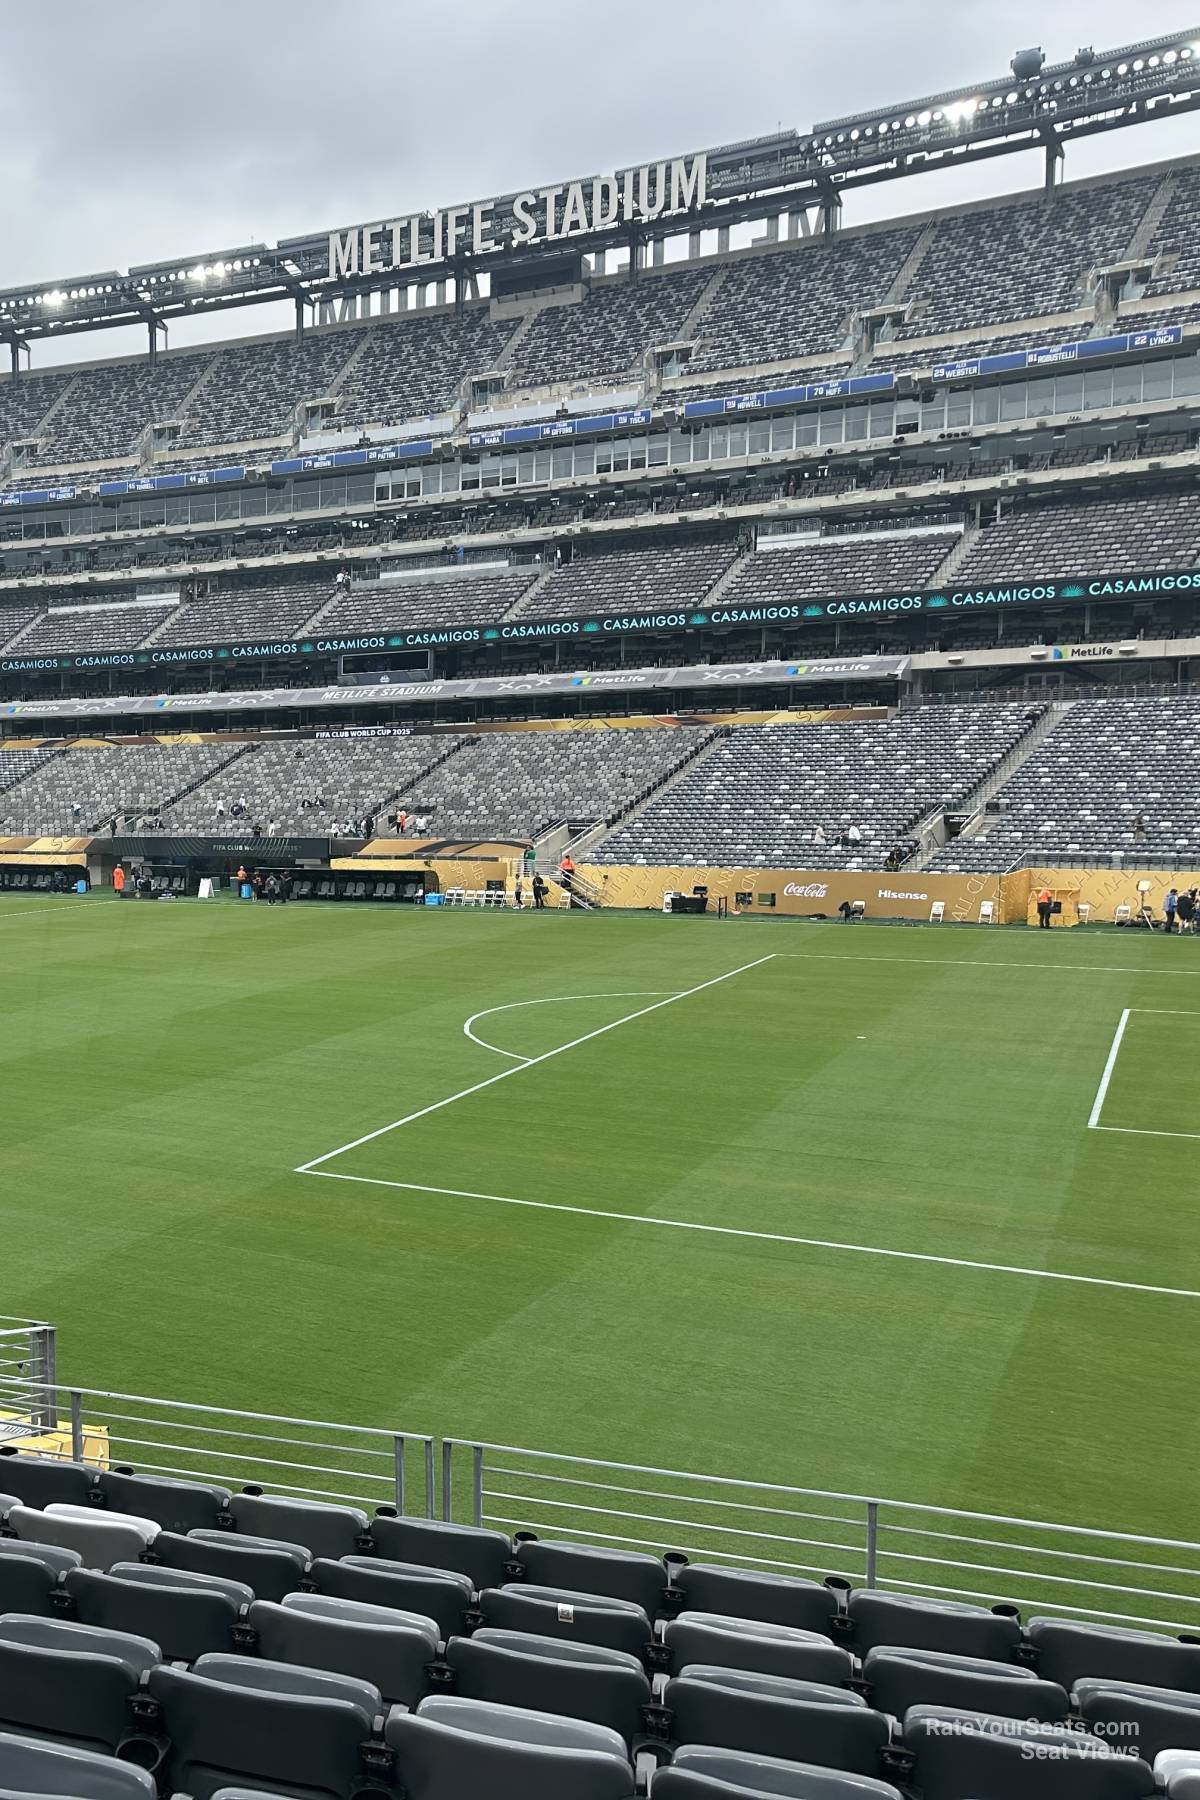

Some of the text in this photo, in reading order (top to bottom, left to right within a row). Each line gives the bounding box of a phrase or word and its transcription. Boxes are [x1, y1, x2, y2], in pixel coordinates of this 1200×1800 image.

[328, 154, 707, 277] METLIFE STADIUM
[1134, 335, 1174, 347] 22 LYNCH
[934, 366, 978, 379] 29 WEBSTER
[814, 387, 824, 396] 70
[1088, 574, 1200, 596] CASAMIGOS
[952, 586, 1056, 607] CASAMIGOS
[826, 596, 922, 616] CASAMIGOS
[711, 606, 799, 624] CASAMIGOS
[603, 614, 686, 631] CASAMIGOS
[502, 622, 579, 638] CASAMIGOS
[406, 629, 480, 645] CASAMIGOS
[232, 643, 297, 657] CASAMIGOS
[317, 637, 385, 651] CASAMIGOS
[152, 649, 213, 662] CASAMIGOS
[1070, 646, 1113, 658] MetLife
[1, 659, 58, 671] CASAMIGOS
[75, 654, 134, 667] CASAMIGOS
[810, 662, 870, 673] MetLife
[593, 674, 646, 686] MetLife
[321, 685, 442, 700] METLIFE STADIUM
[171, 697, 212, 707] MetLife
[22, 705, 60, 714] MetLife
[878, 889, 928, 901] Hisense
